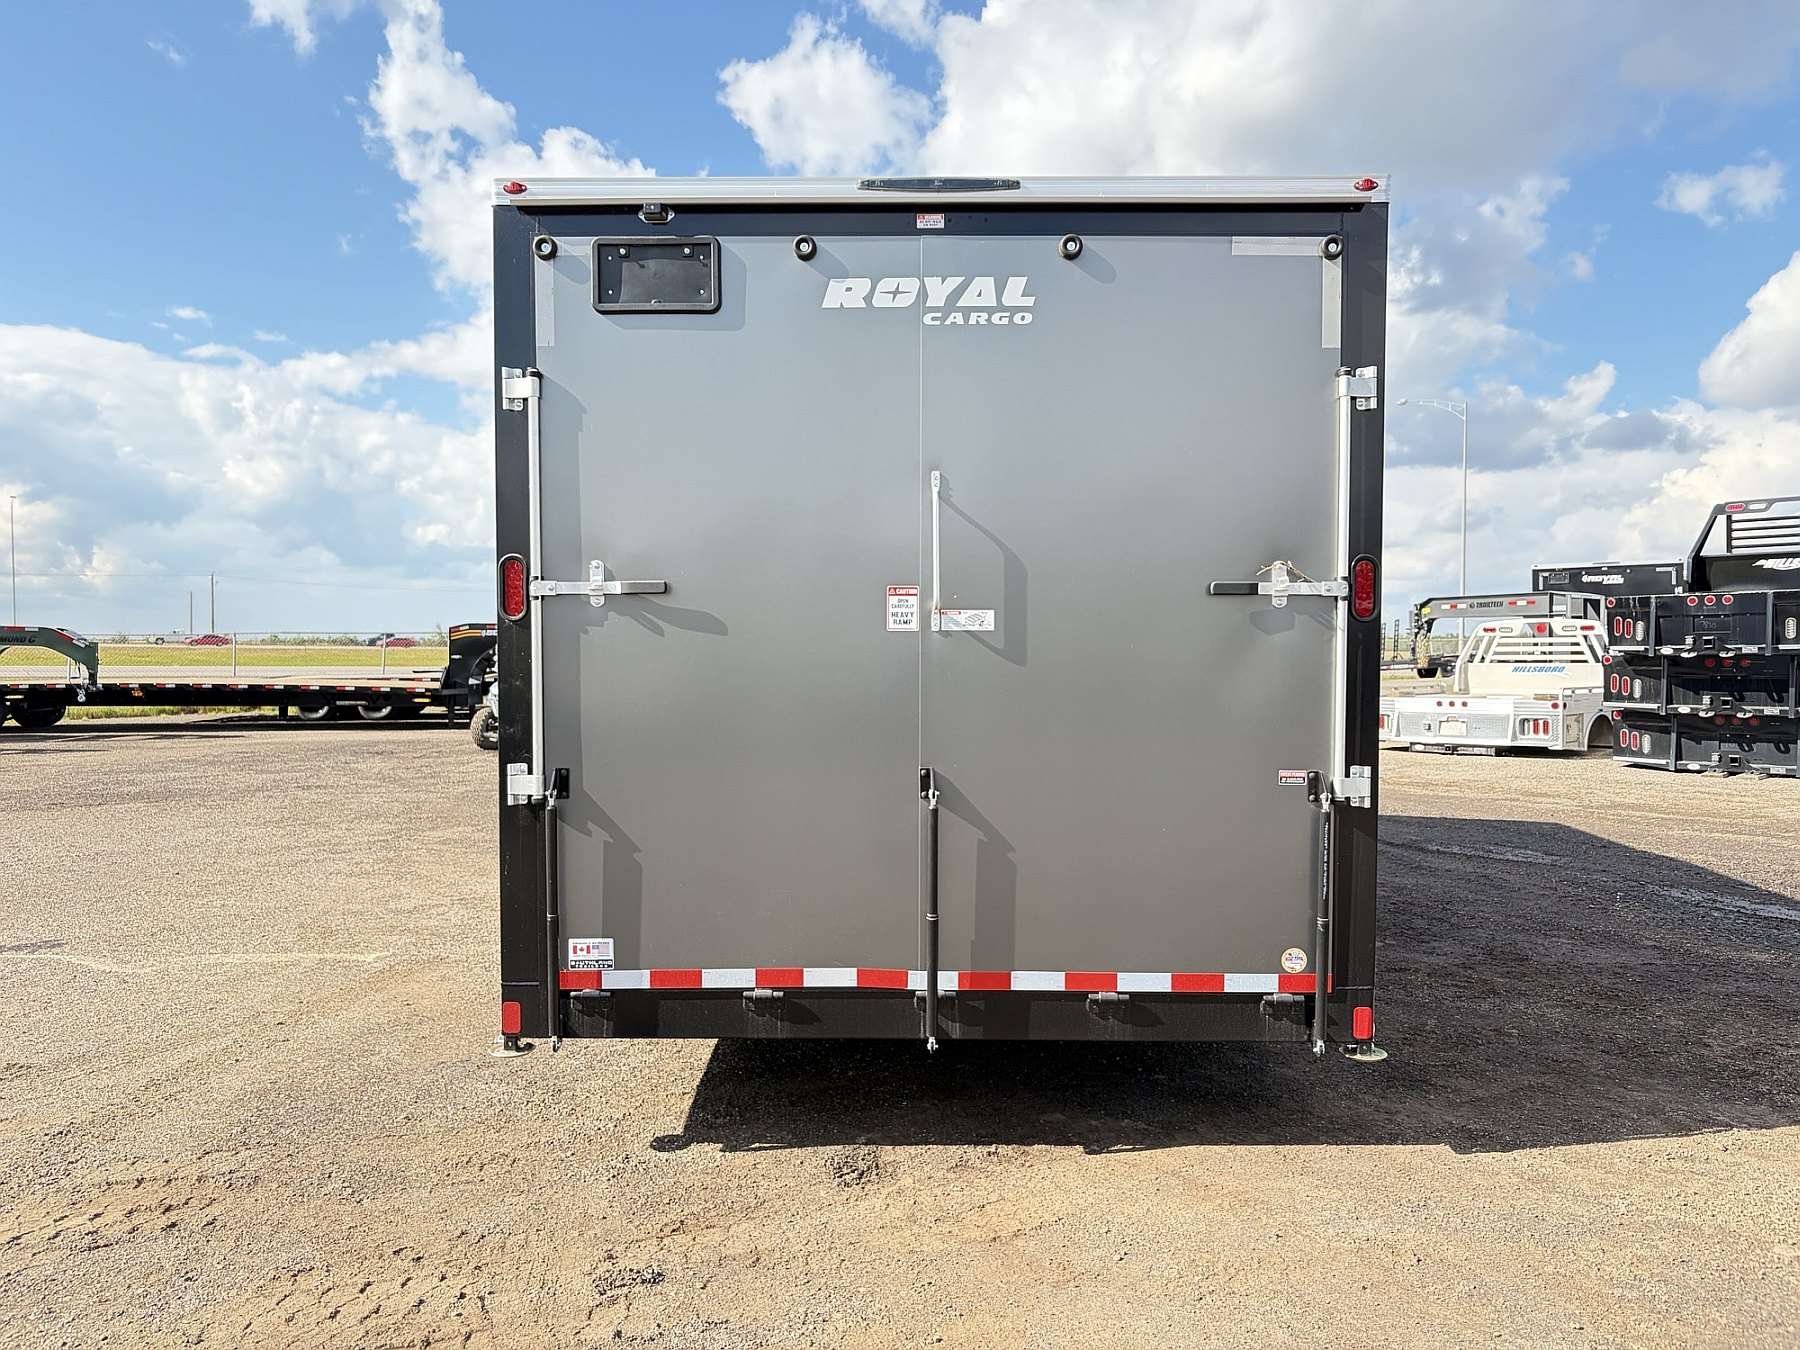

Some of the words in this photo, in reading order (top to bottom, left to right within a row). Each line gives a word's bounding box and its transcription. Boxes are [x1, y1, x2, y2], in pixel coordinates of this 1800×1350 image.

[821, 276, 1036, 309] ROYAL
[922, 312, 1033, 325] CARGO
[1511, 665, 1567, 673] HILLSBORO
